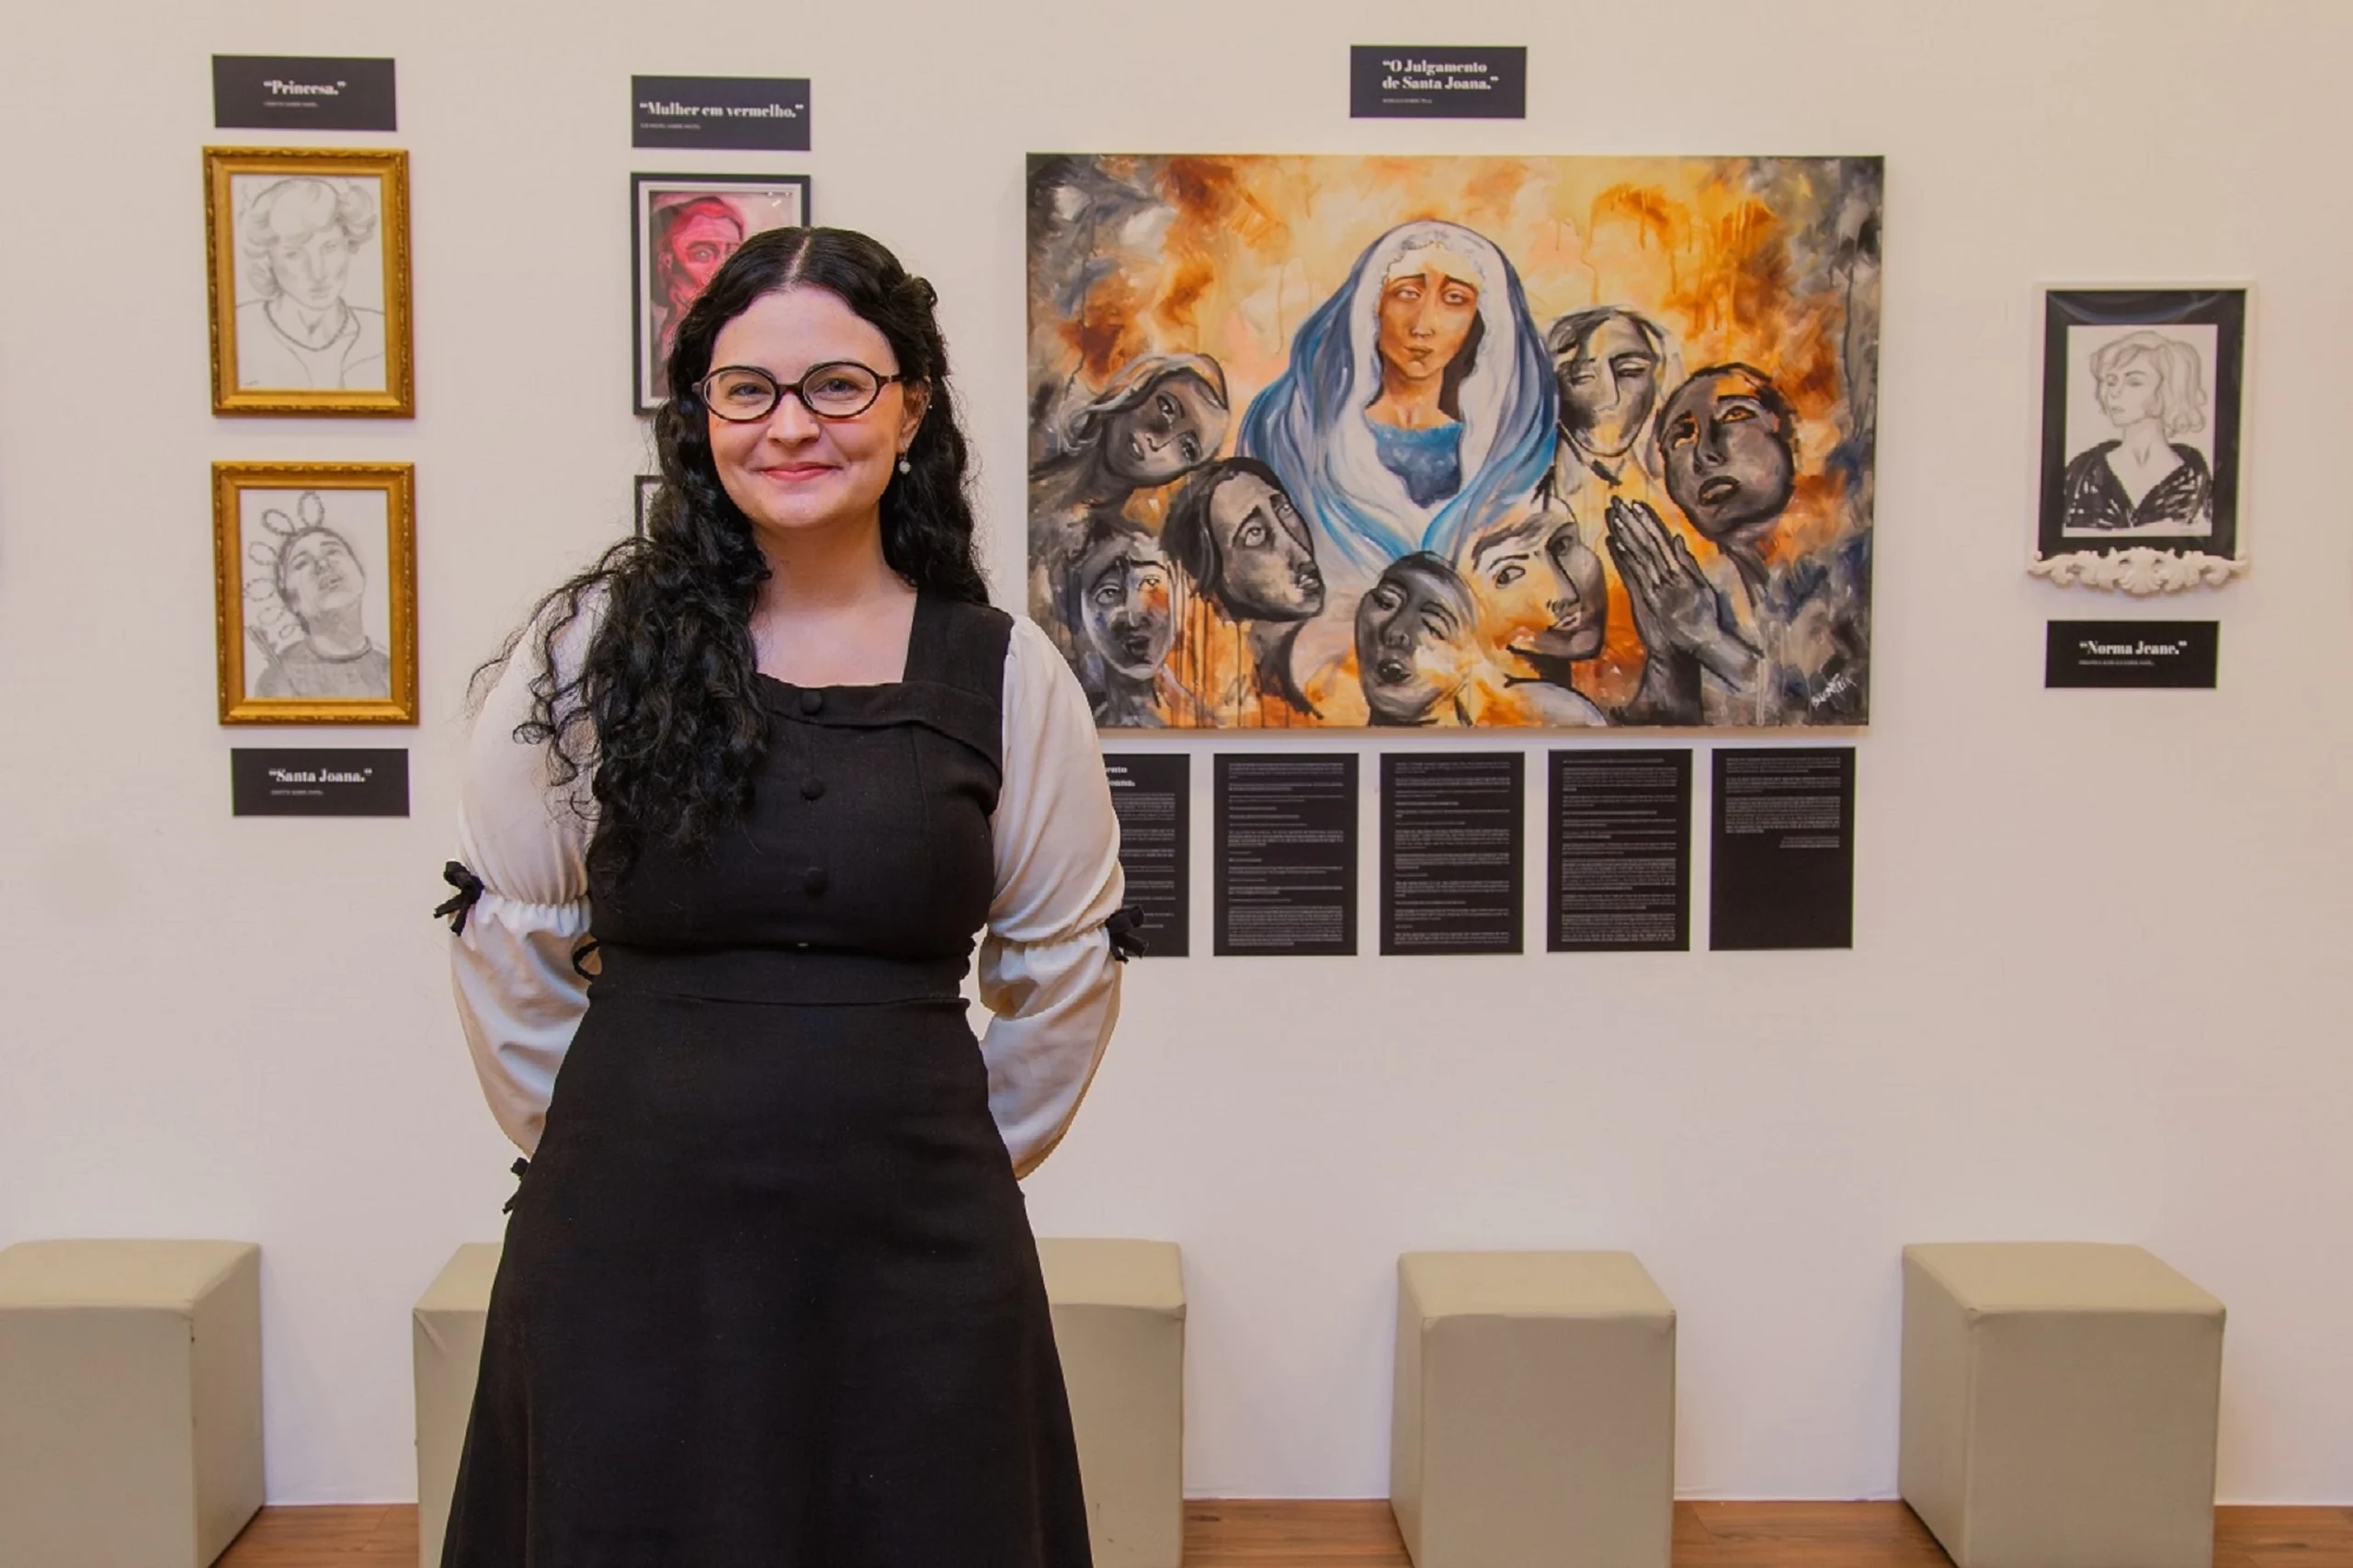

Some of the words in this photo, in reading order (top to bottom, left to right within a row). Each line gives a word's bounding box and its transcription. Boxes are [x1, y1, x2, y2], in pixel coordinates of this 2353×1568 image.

[1404, 59, 1487, 75] Julgamento
[1381, 75, 1400, 89] de
[1402, 75, 1442, 89] Santa
[701, 105, 724, 117] em
